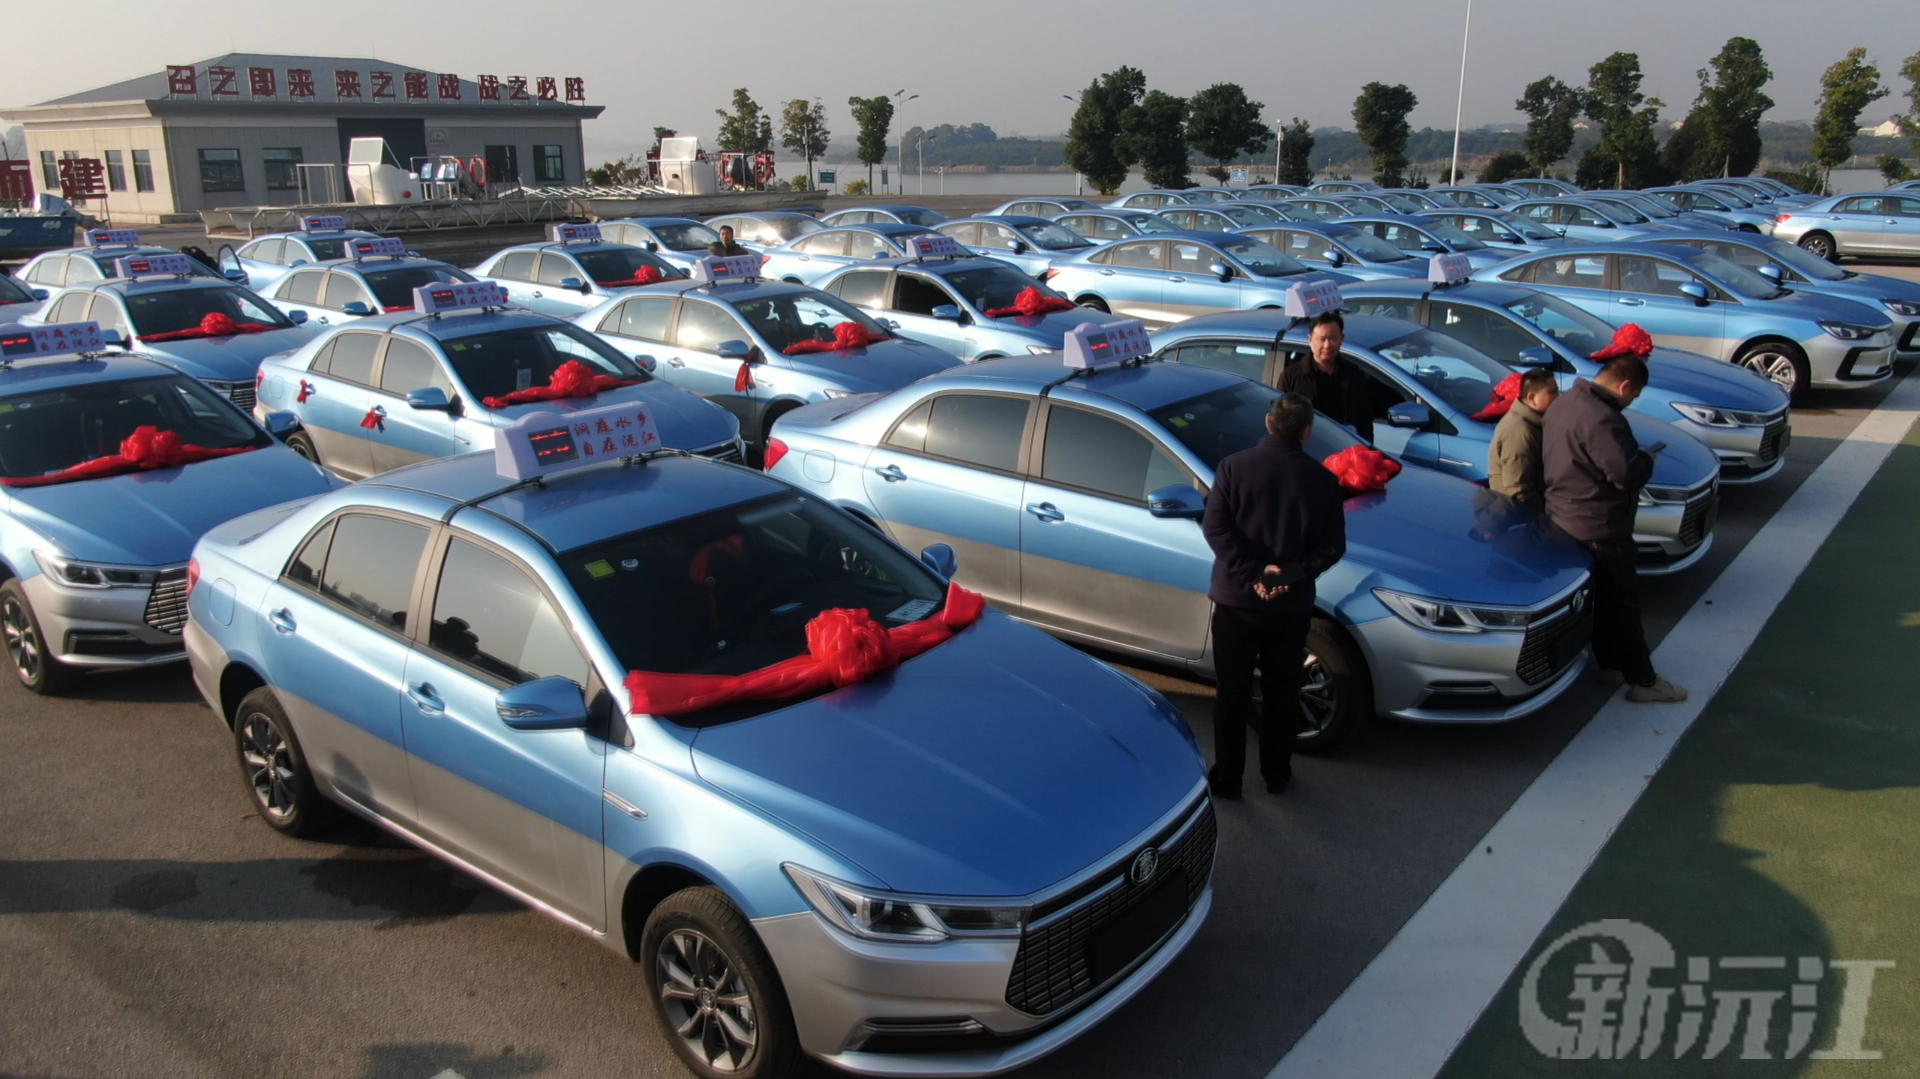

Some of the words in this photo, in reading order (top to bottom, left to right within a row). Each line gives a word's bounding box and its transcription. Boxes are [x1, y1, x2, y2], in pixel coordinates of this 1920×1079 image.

[167, 65, 315, 97] 召之即来
[335, 70, 461, 99] 来之能战
[478, 75, 586, 101] 战之必胜
[574, 411, 647, 437] 洞庭水乡
[583, 431, 657, 456] 自在沅江
